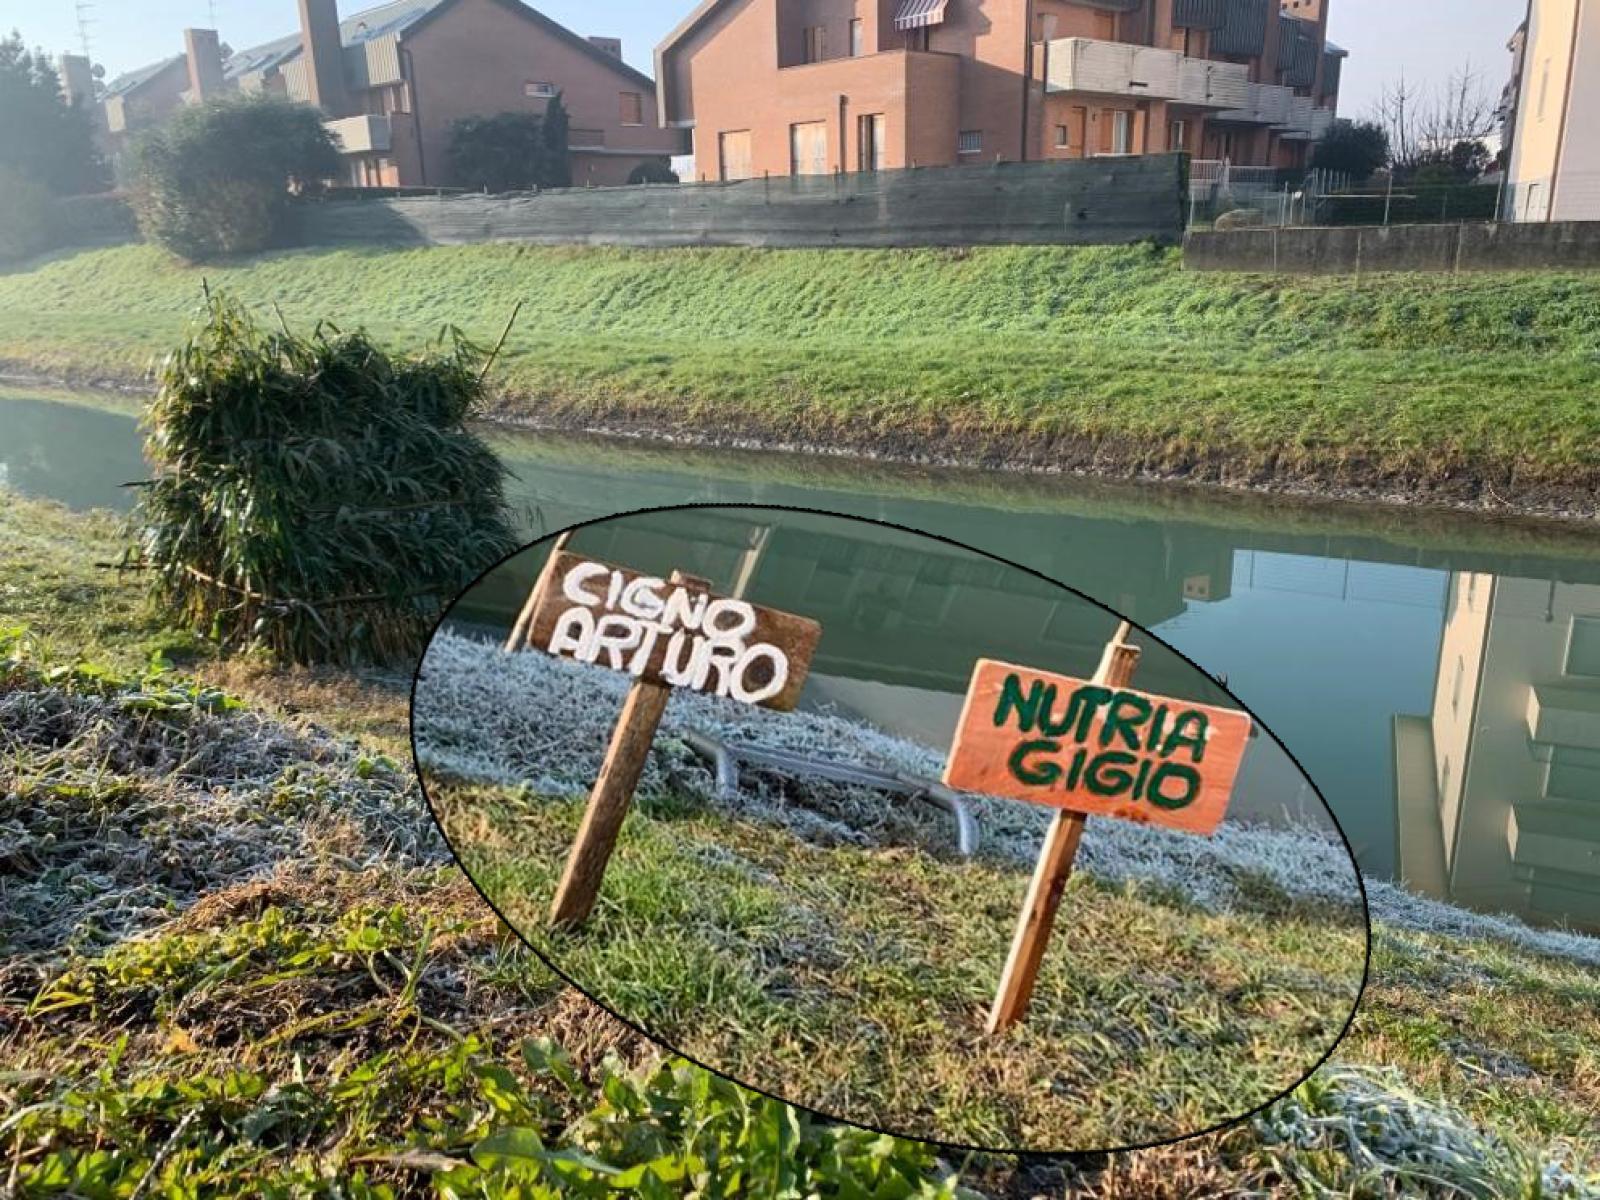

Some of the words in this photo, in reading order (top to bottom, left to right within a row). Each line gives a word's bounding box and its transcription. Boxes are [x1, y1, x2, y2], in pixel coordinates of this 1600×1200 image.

[562, 561, 757, 638] CIGNO
[548, 606, 789, 702] ARTURO
[993, 672, 1209, 763] NUTRIA
[1008, 739, 1202, 811] GIGIO
